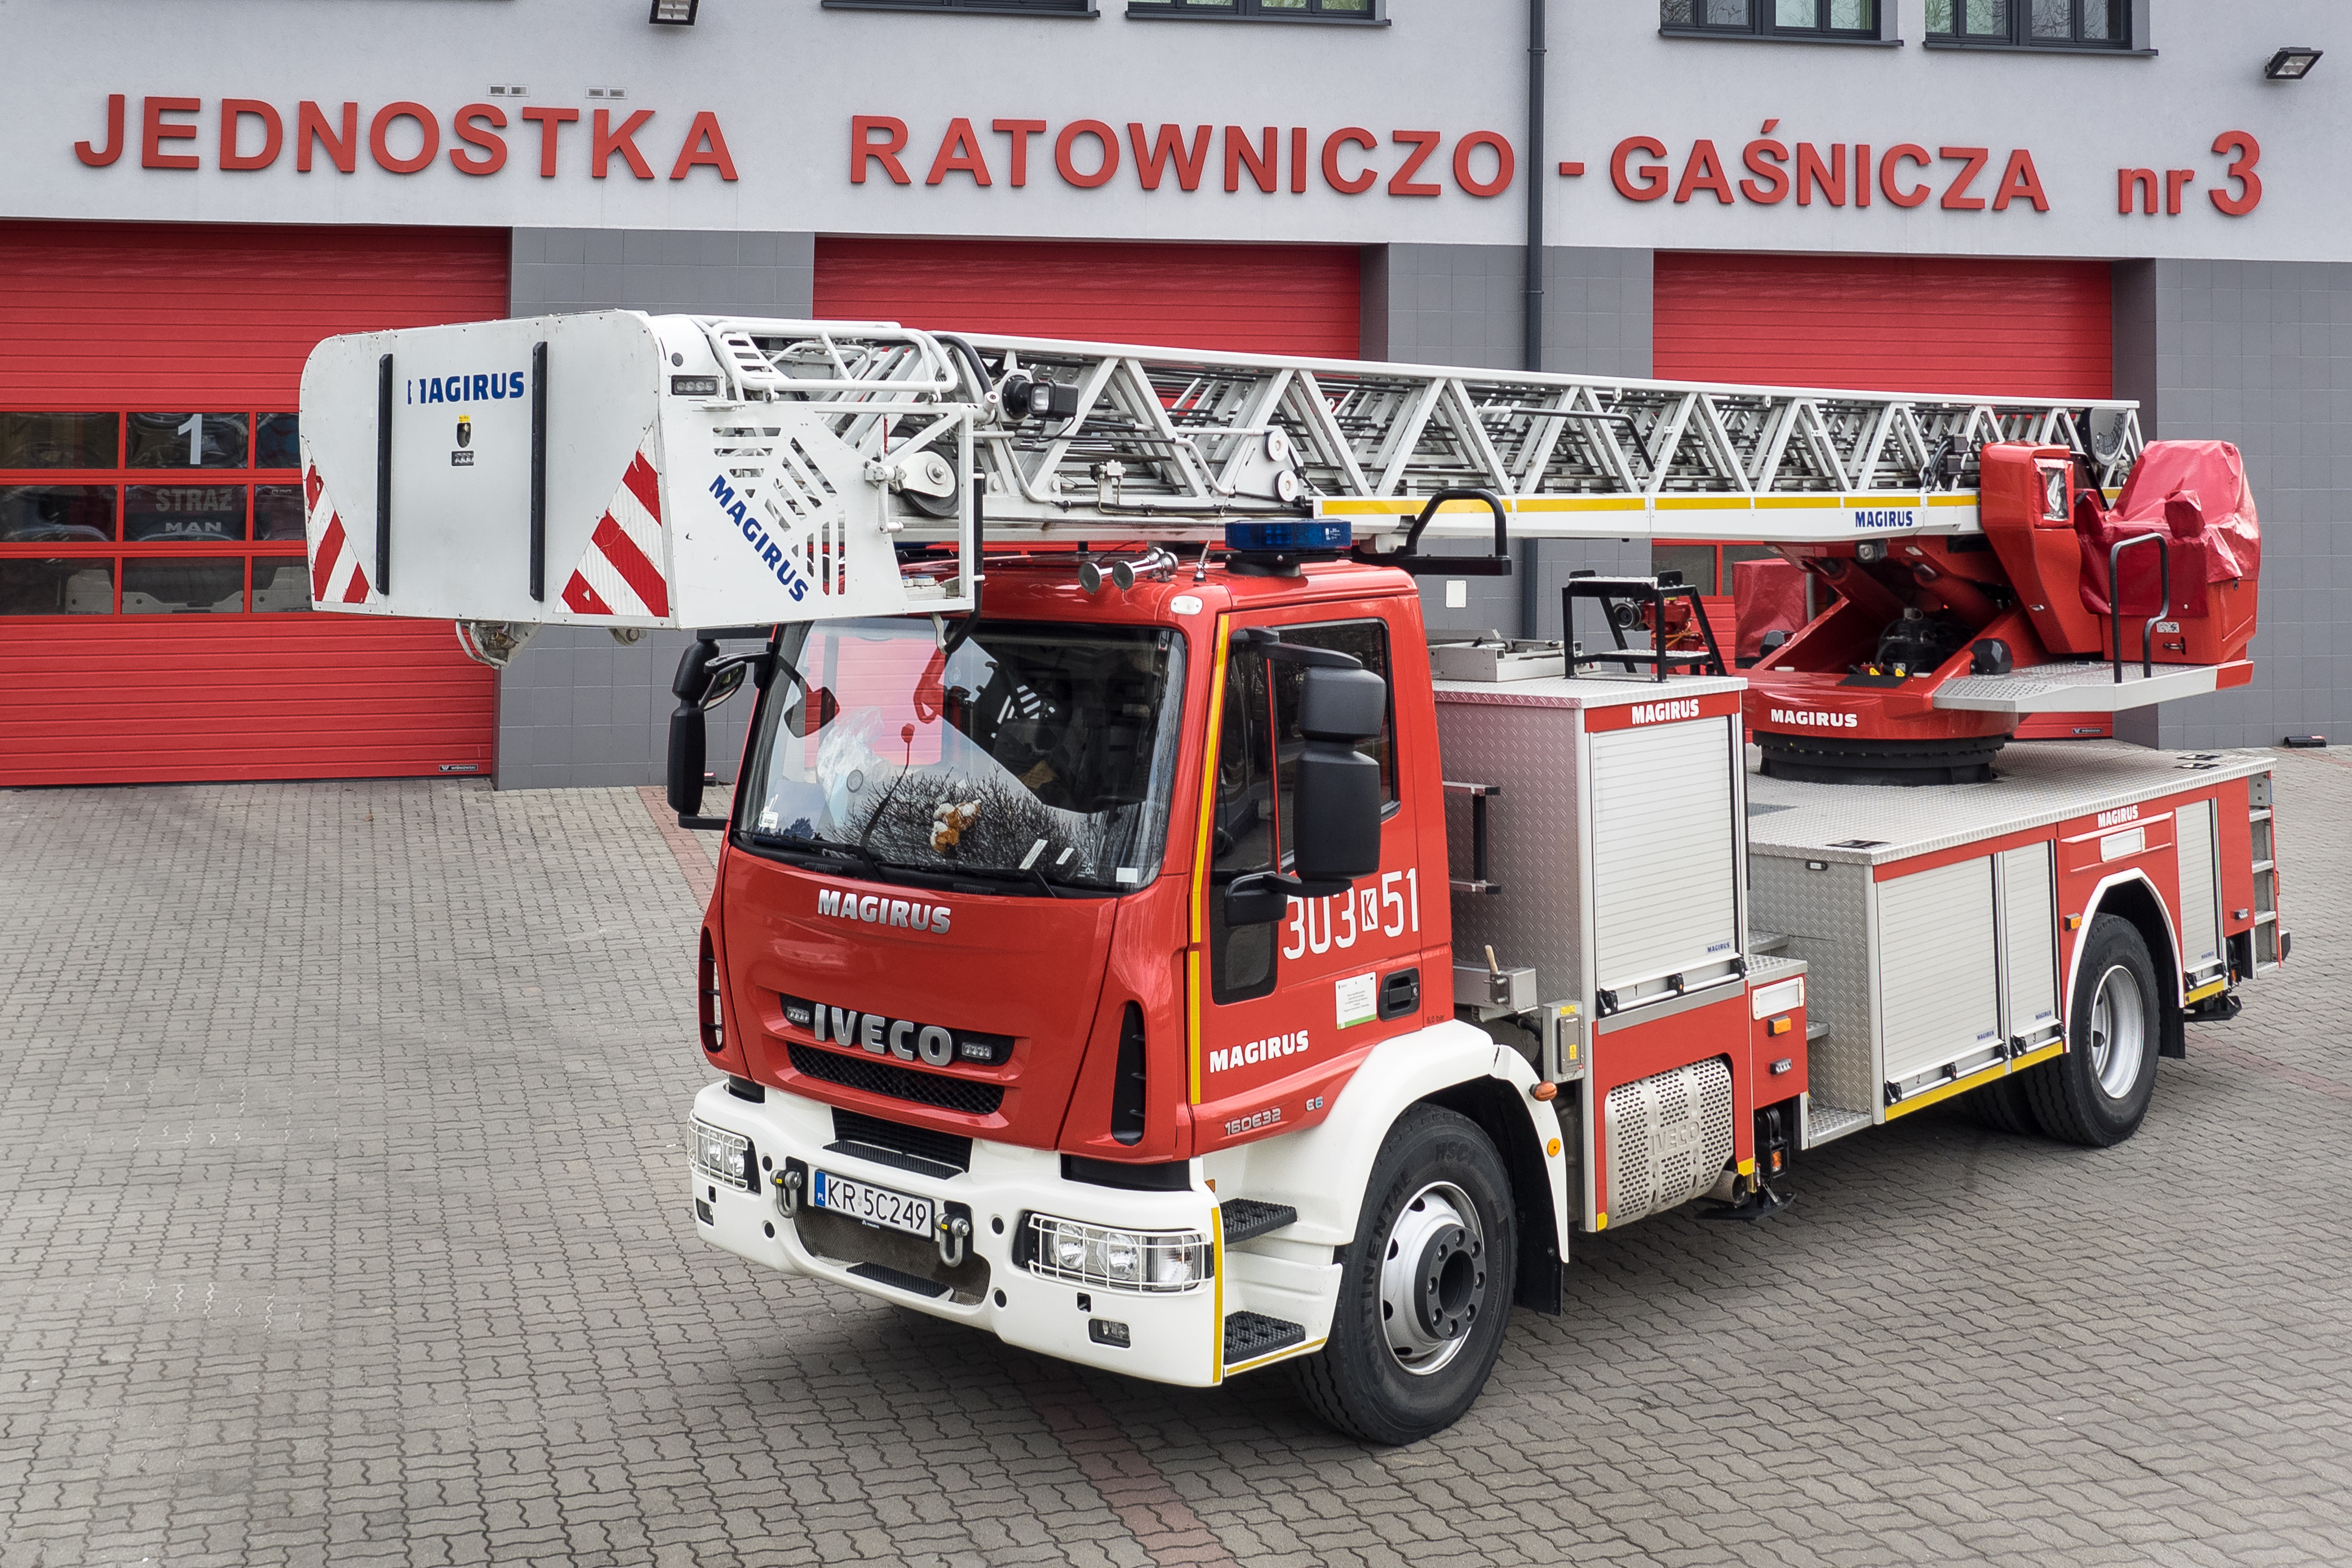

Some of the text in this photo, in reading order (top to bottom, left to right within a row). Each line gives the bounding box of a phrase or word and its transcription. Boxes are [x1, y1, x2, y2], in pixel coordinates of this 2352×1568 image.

[74, 94, 738, 180] JEDNOSTKA
[851, 116, 1514, 197] RATOWNICZO
[1610, 119, 2049, 211] GAŚNICZA
[2119, 169, 2195, 214] nr
[2209, 131, 2262, 215] 3
[178, 414, 202, 464] 1
[156, 489, 232, 512] STRAŻ
[165, 522, 222, 532] MAN
[1855, 511, 1913, 528] MAGIRUS
[709, 475, 808, 602] MAGIRUS
[1632, 699, 1699, 725] MAGIRUS
[1771, 708, 1858, 728] MAGIRUS
[2097, 805, 2138, 829] MAGIRUS
[817, 889, 951, 934] MAGIRUS
[1707, 942, 1730, 953] MAGIRUS
[1634, 984, 1638, 996] 1
[814, 1003, 953, 1066] IVECO
[1210, 1030, 1309, 1073] MAGIRUS
[1306, 1096, 1323, 1111] E6
[1225, 1108, 1281, 1136] 160E32
[1649, 1121, 1700, 1157] IVECO
[817, 1192, 825, 1201] PL
[828, 1178, 927, 1230] KR 5C249
